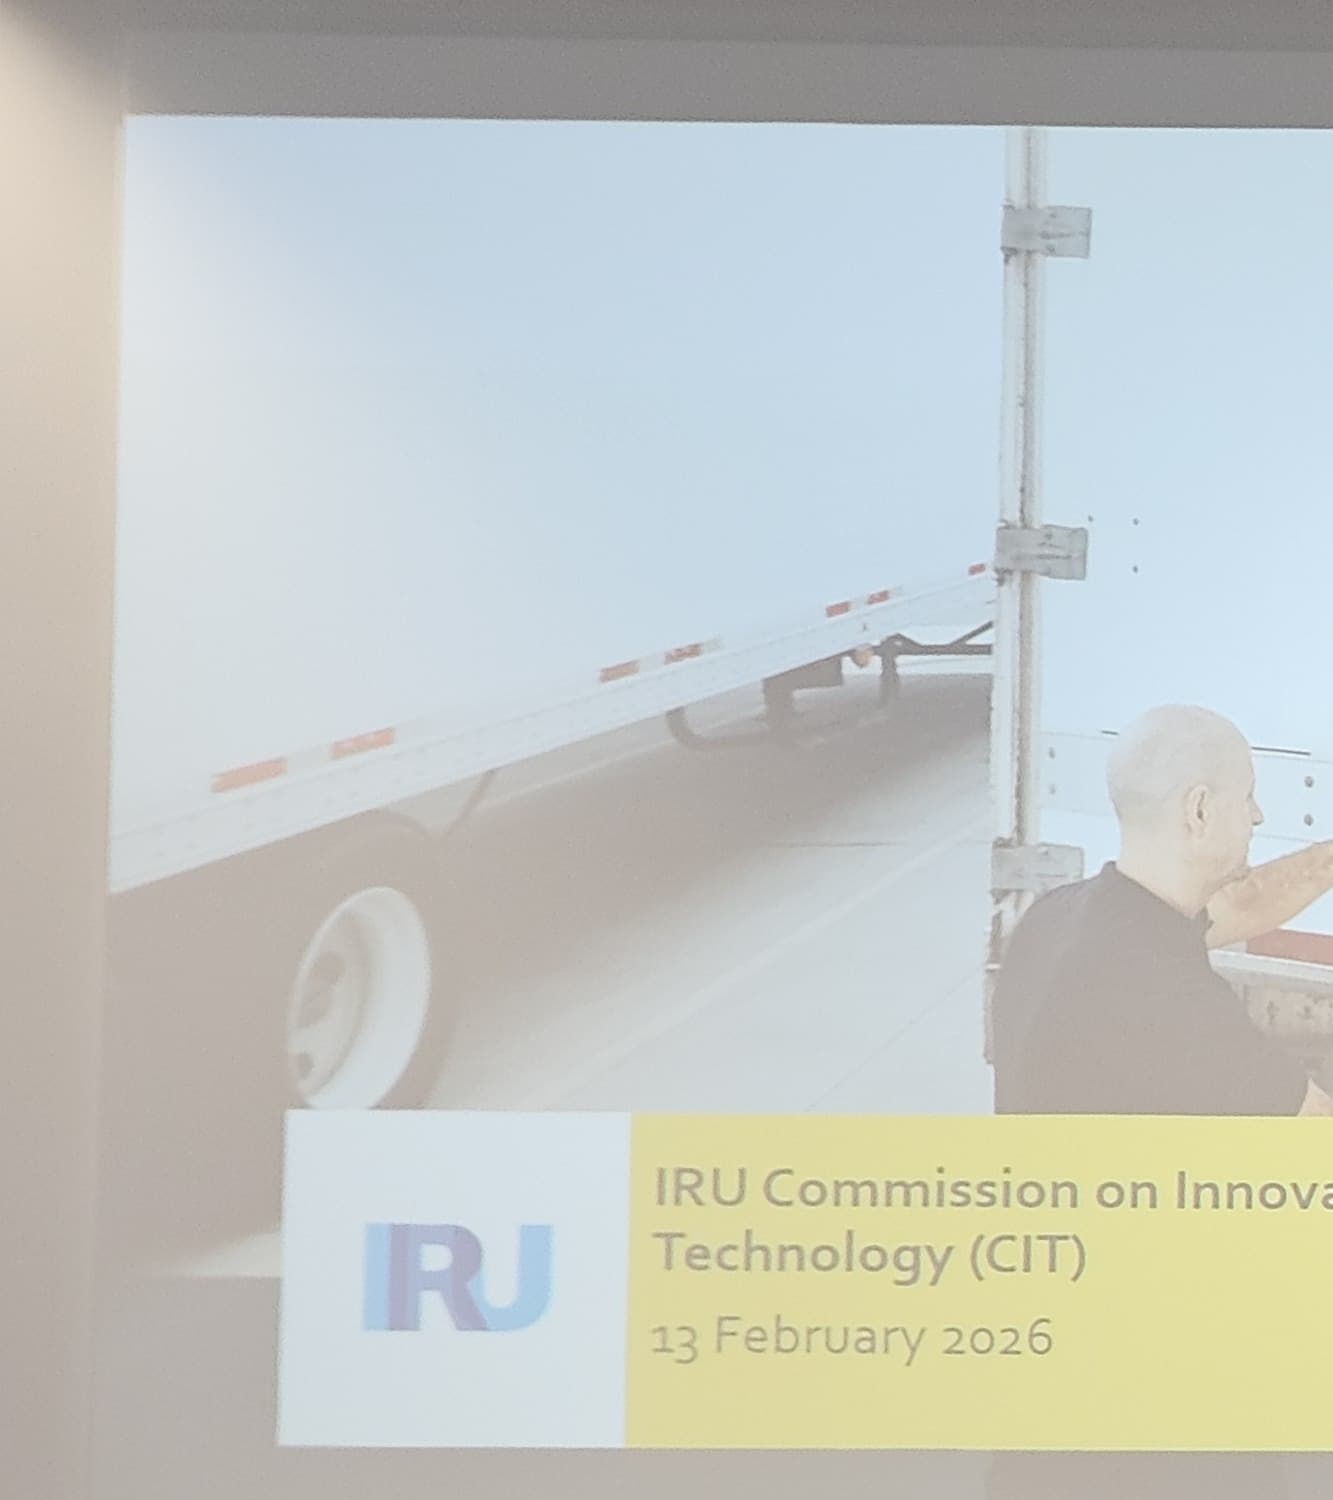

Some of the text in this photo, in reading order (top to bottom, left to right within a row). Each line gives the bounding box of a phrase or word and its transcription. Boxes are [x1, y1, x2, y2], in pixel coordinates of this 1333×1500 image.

[654, 1165, 748, 1207] IRU
[762, 1166, 1080, 1210] Commission
[1095, 1180, 1159, 1210] on
[362, 1223, 554, 1332] IRU
[650, 1229, 1087, 1287] Technology (CIT)
[650, 1314, 1054, 1367] 13 February 2026
